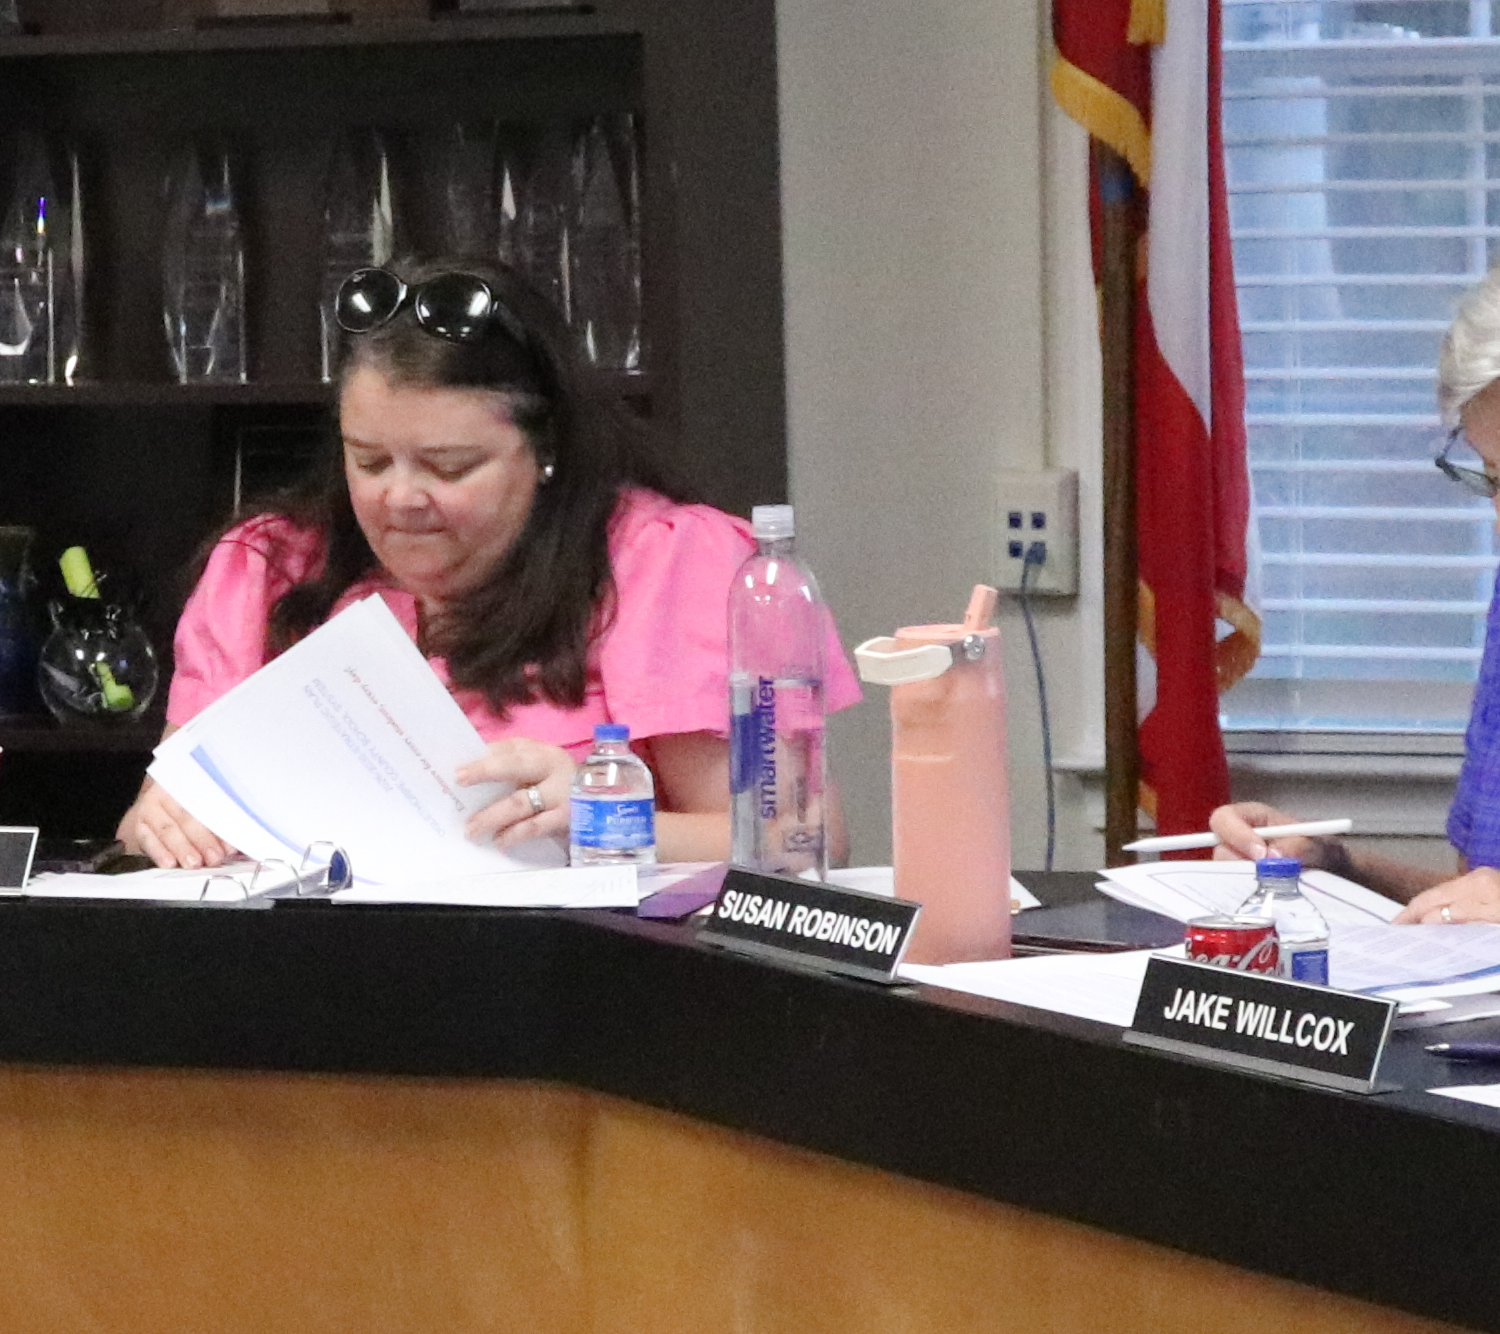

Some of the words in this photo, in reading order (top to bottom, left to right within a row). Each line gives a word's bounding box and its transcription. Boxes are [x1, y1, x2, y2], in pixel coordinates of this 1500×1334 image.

[759, 675, 777, 820] smartwater
[718, 890, 790, 930] SUSAN
[787, 904, 901, 955] ROBINSON
[1163, 988, 1233, 1030] JAKE
[1235, 1000, 1355, 1056] WILLCOX
